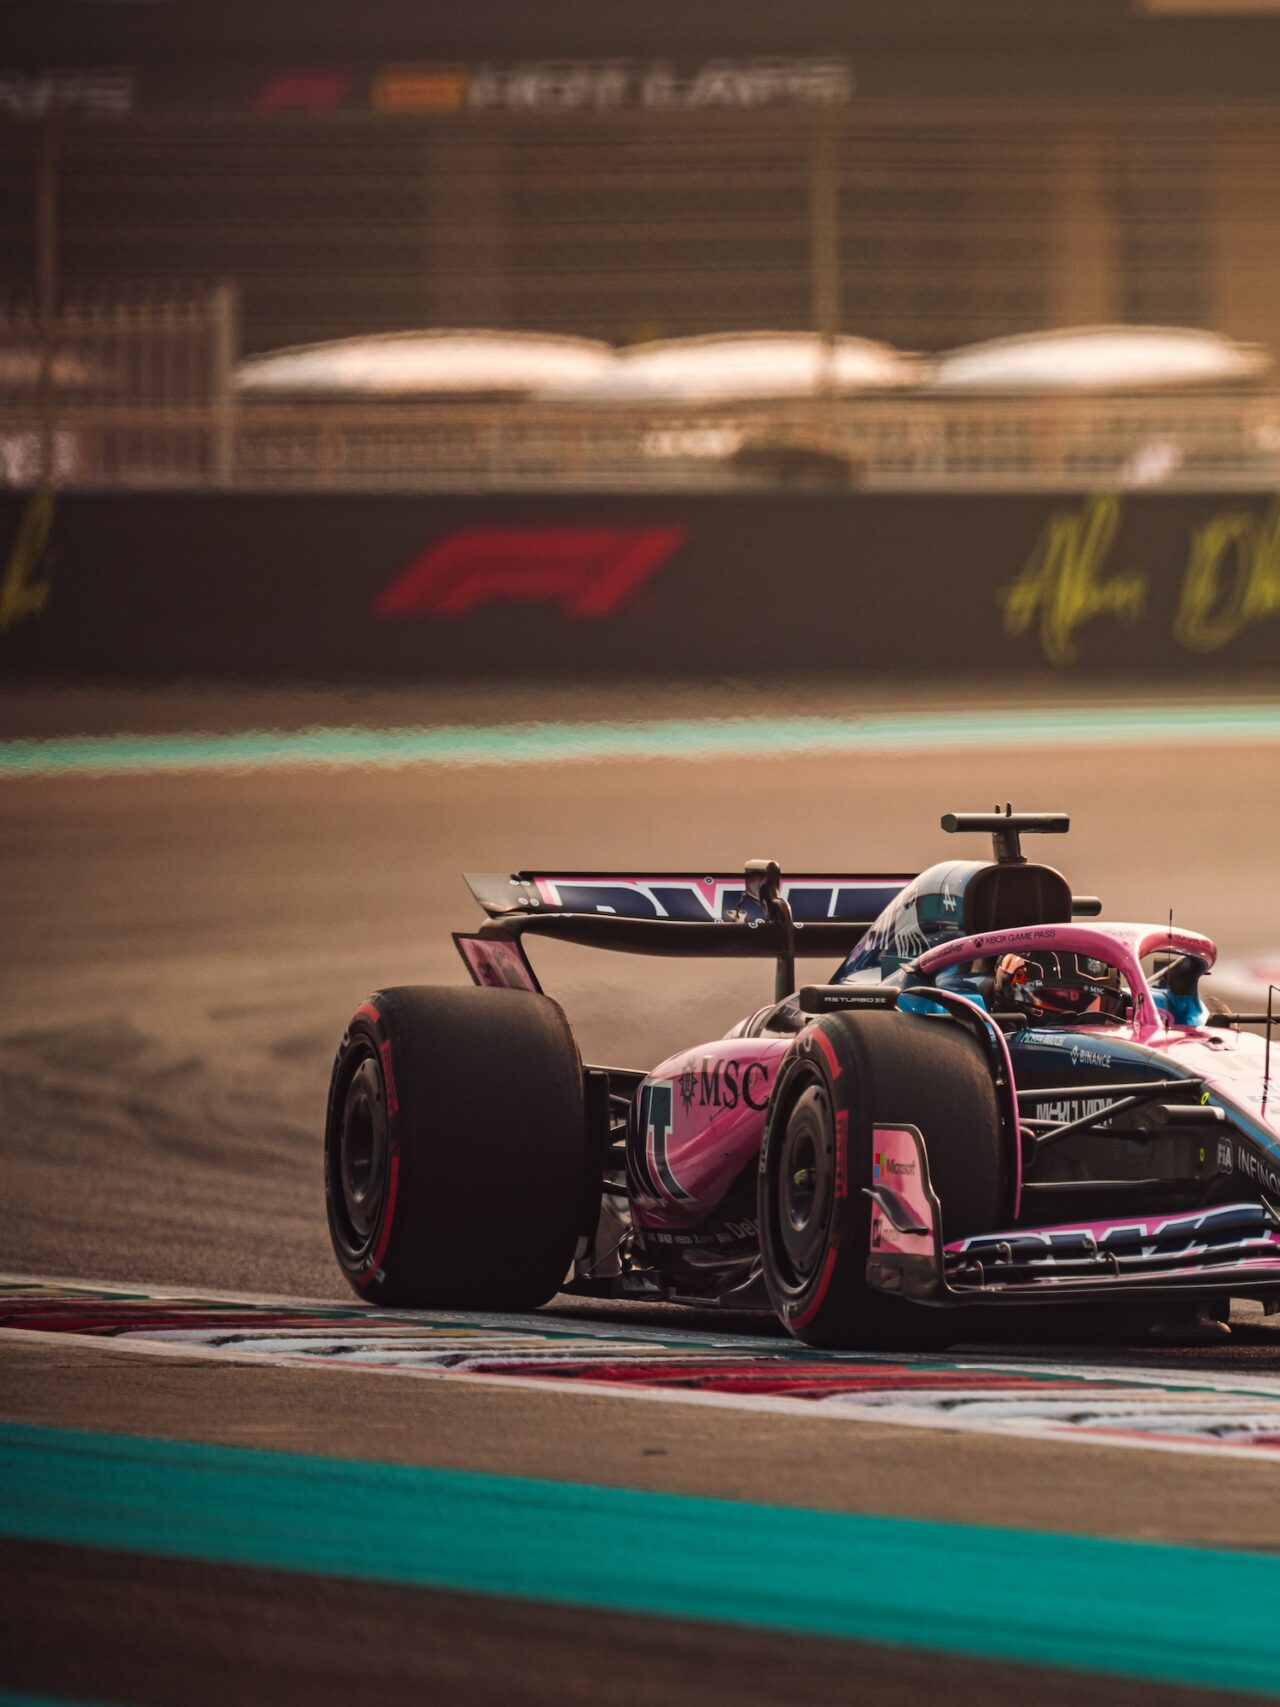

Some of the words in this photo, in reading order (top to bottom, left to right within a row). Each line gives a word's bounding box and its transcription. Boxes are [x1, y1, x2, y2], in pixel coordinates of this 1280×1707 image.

[985, 935, 1007, 945] XBOX
[1008, 932, 1032, 942] GAME
[1034, 929, 1056, 939] PASS
[1089, 985, 1105, 995] MSC
[1080, 1048, 1111, 1068] BINANCE
[700, 1057, 770, 1111] MSC
[1217, 1143, 1232, 1168] FIA
[886, 1158, 916, 1177] Microsoft
